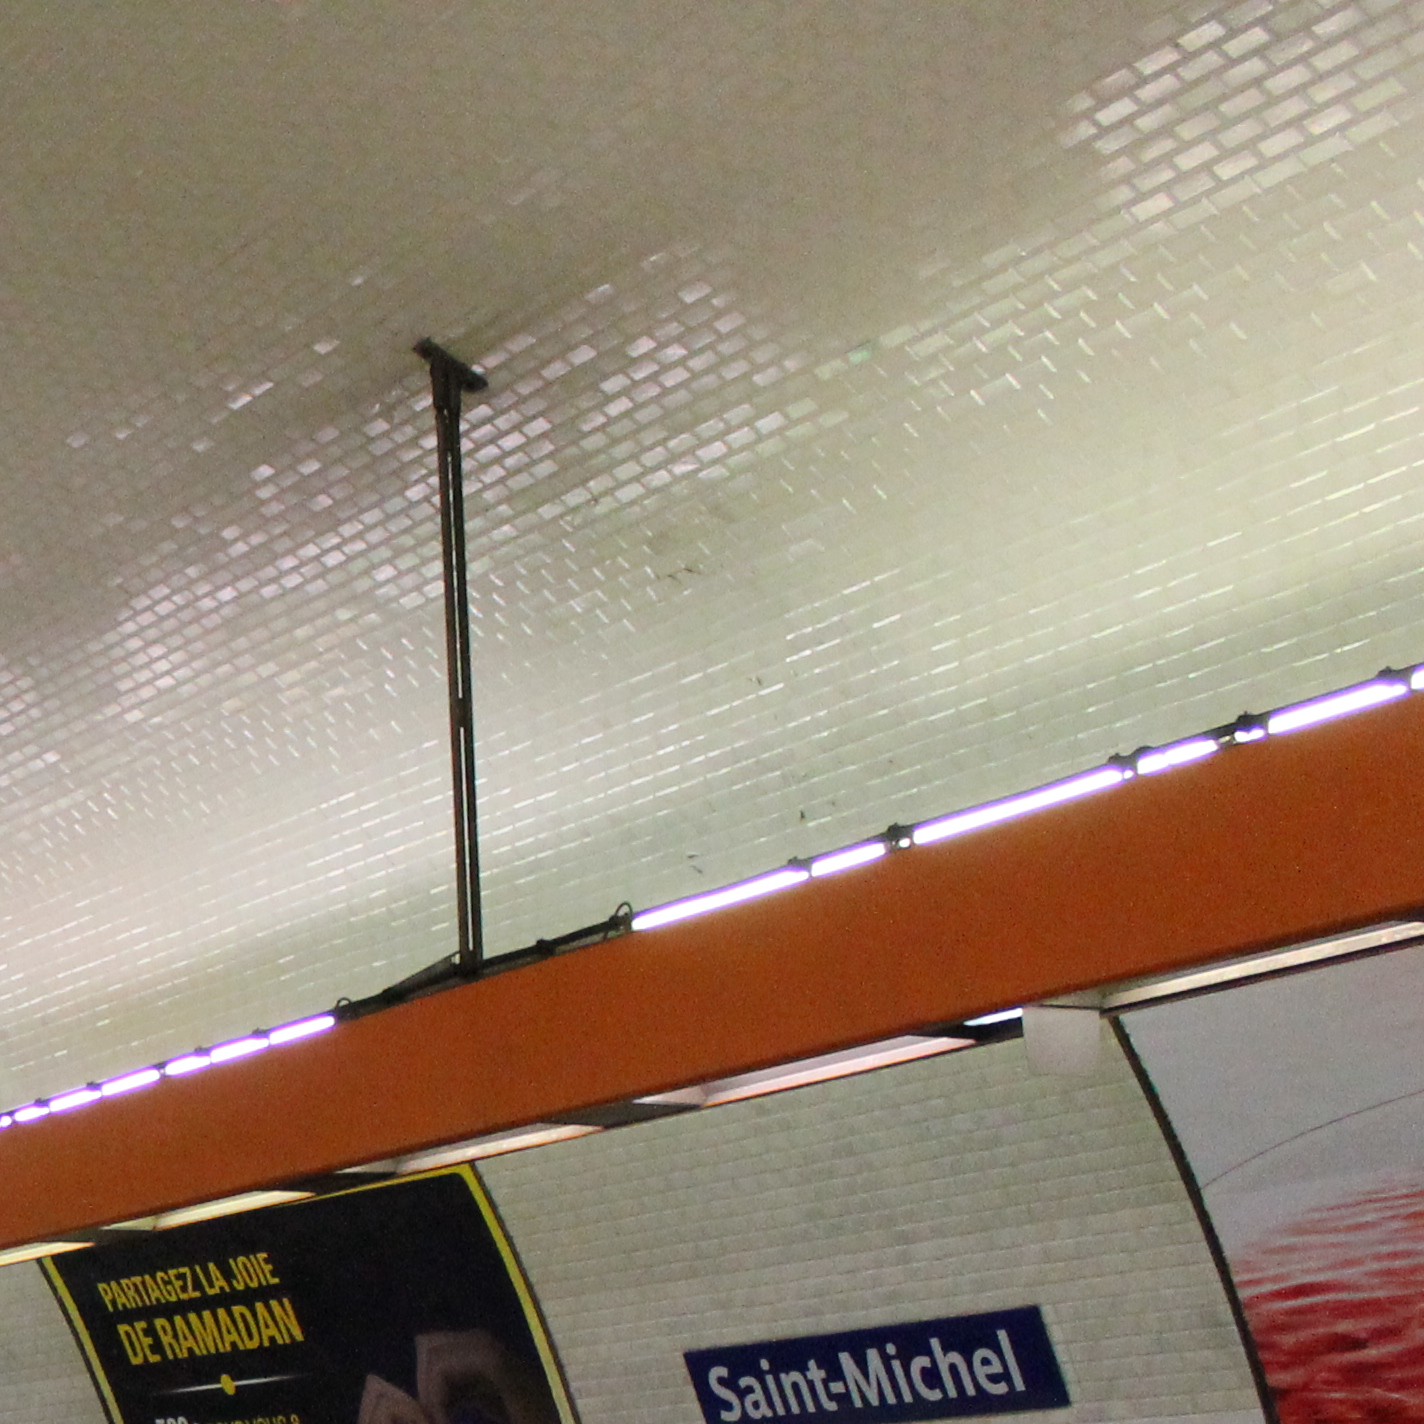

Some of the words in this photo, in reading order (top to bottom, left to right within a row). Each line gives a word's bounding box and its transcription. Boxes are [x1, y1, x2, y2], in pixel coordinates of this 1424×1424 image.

[97, 1266, 202, 1313] PARTAGEZ
[194, 1261, 231, 1296] LA
[228, 1252, 281, 1291] JOIE
[116, 1320, 162, 1366] DE
[154, 1297, 306, 1361] RAMADAN
[707, 1329, 1027, 1423] Saint-Michel
